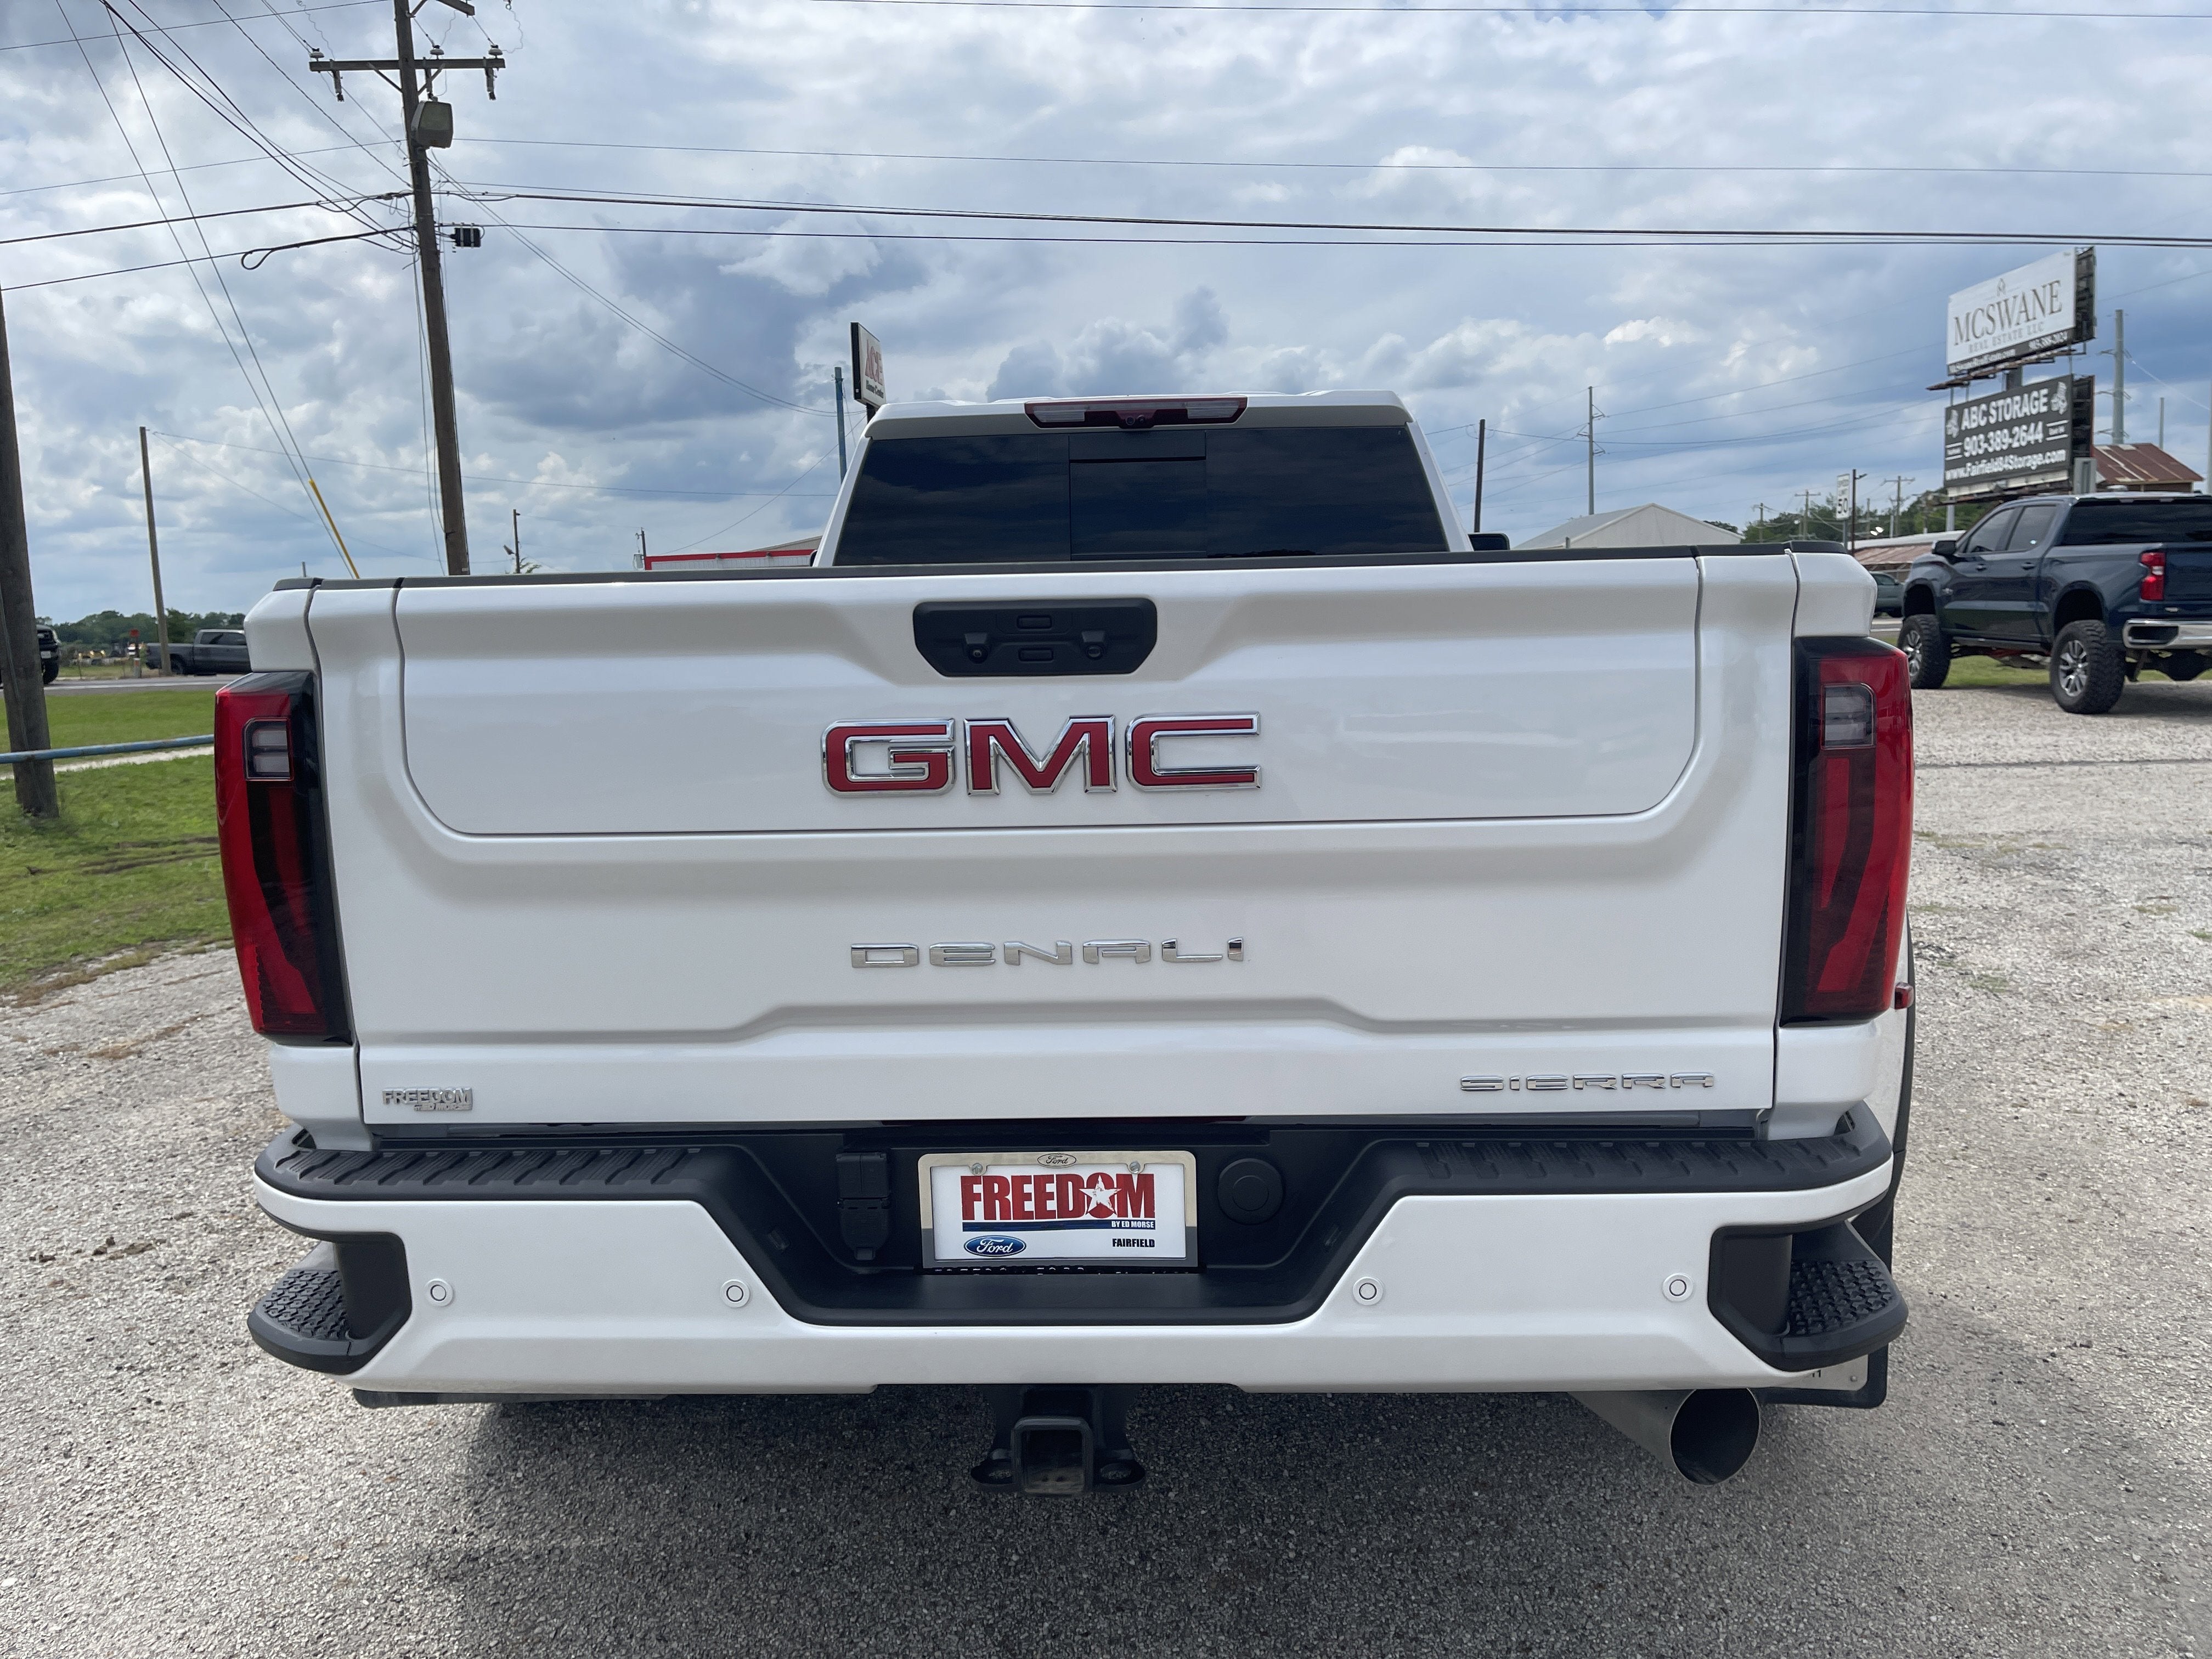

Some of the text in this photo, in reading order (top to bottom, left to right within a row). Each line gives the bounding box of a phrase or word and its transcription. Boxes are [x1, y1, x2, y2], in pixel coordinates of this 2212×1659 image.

[1954, 280, 2063, 346] MCSWANE
[1968, 341, 1988, 353] REAL
[1992, 329, 2023, 346] ESTATE
[2027, 321, 2044, 334] LLC
[1961, 388, 2049, 430] ABC STORAGE
[1963, 421, 2044, 458] 903-389-2644
[821, 710, 1262, 797] GMC
[850, 936, 1244, 968] DENALI
[382, 1087, 473, 1105] FREEDOM
[1460, 1073, 1714, 1092] SIERRA
[1046, 1155, 1069, 1164] Ford
[961, 1172, 1156, 1220] FREEDOM
[976, 1238, 1014, 1253] Ford
[1112, 1238, 1155, 1248] FAIRFIELD
